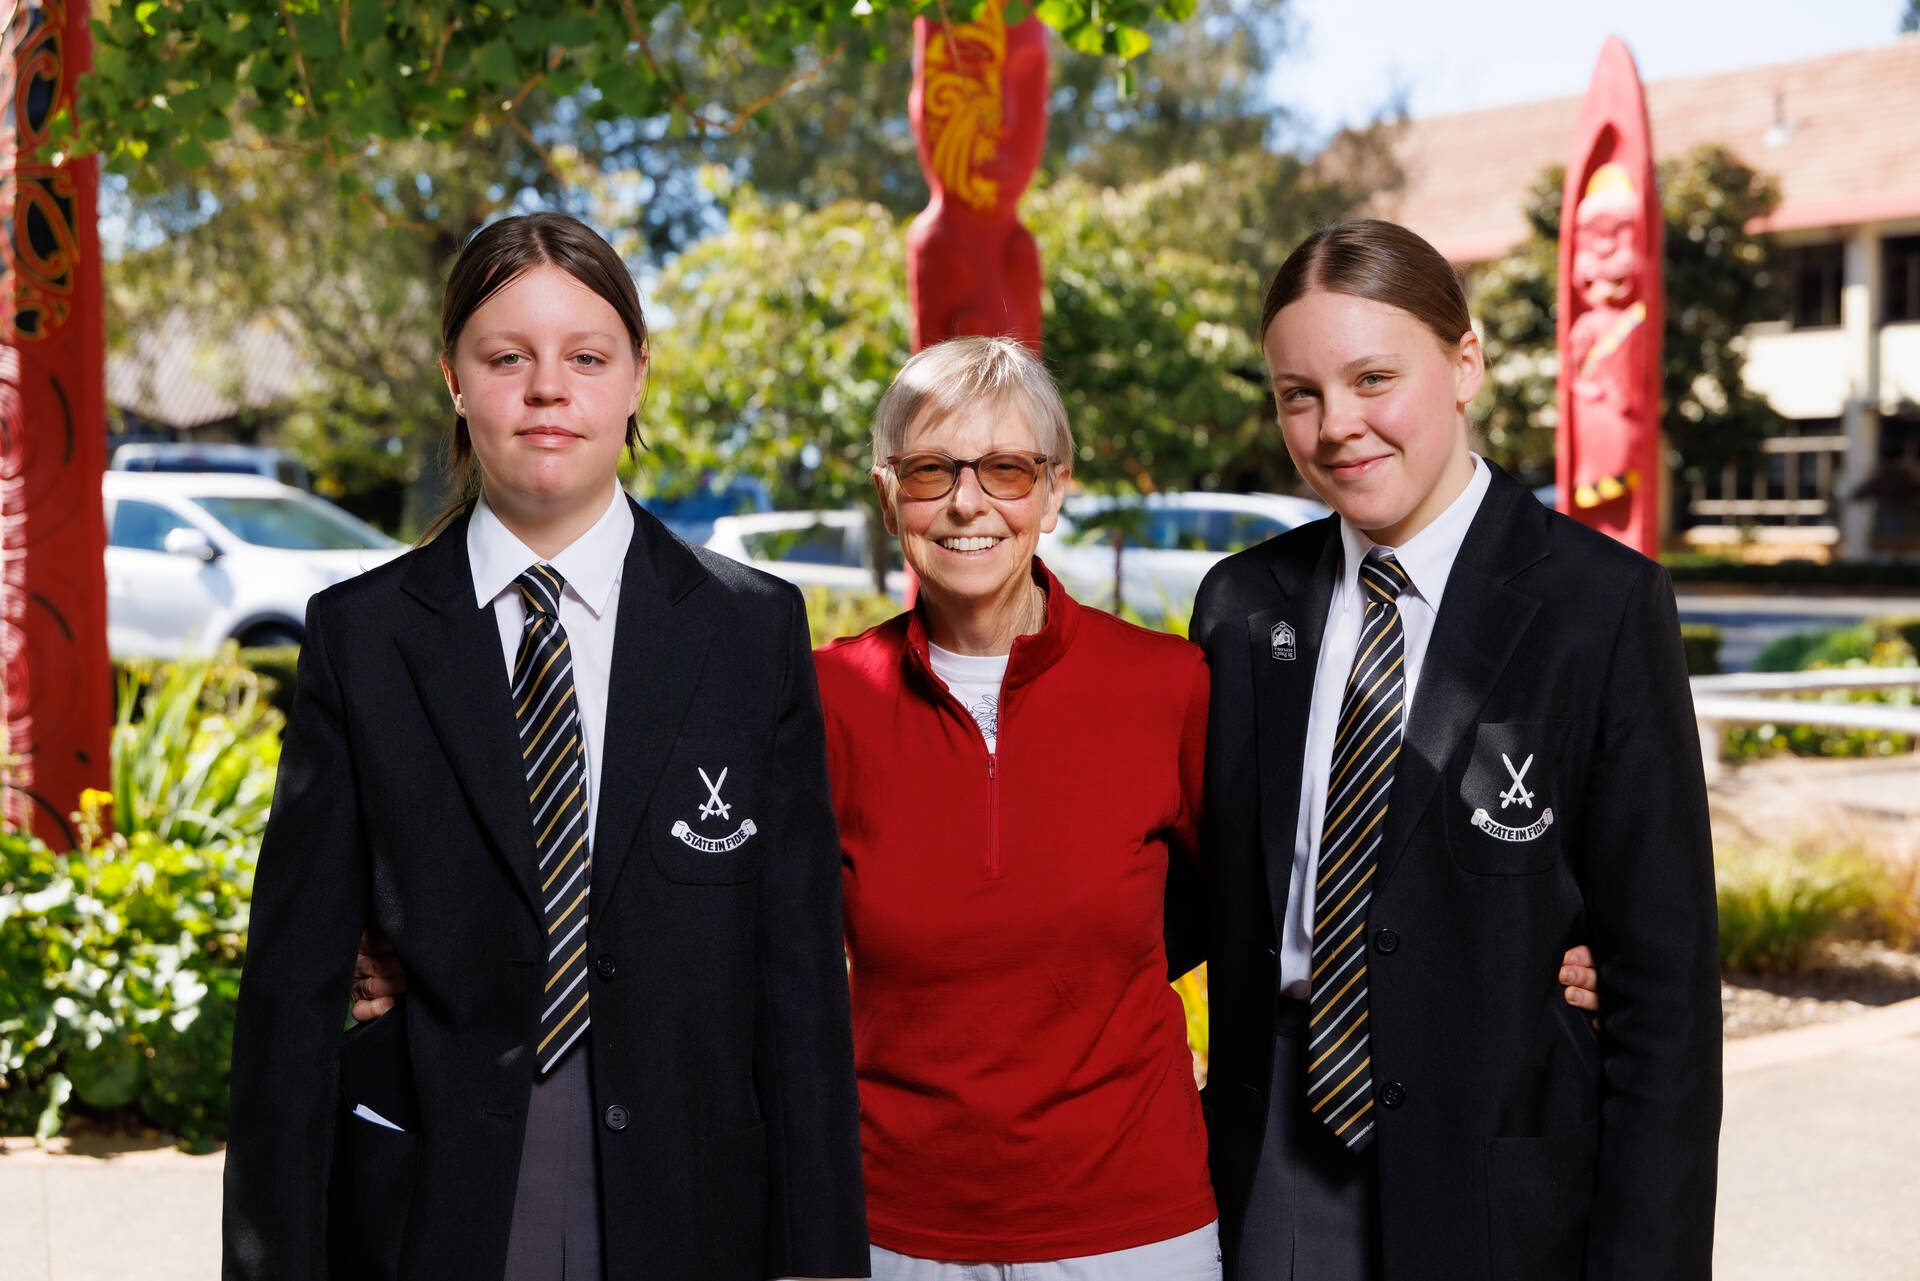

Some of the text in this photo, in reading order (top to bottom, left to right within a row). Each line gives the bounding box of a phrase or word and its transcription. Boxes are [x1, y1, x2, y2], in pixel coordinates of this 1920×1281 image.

[1482, 819, 1547, 840] STATE IN FIDE
[684, 830, 747, 851] STATE IN FIDE
